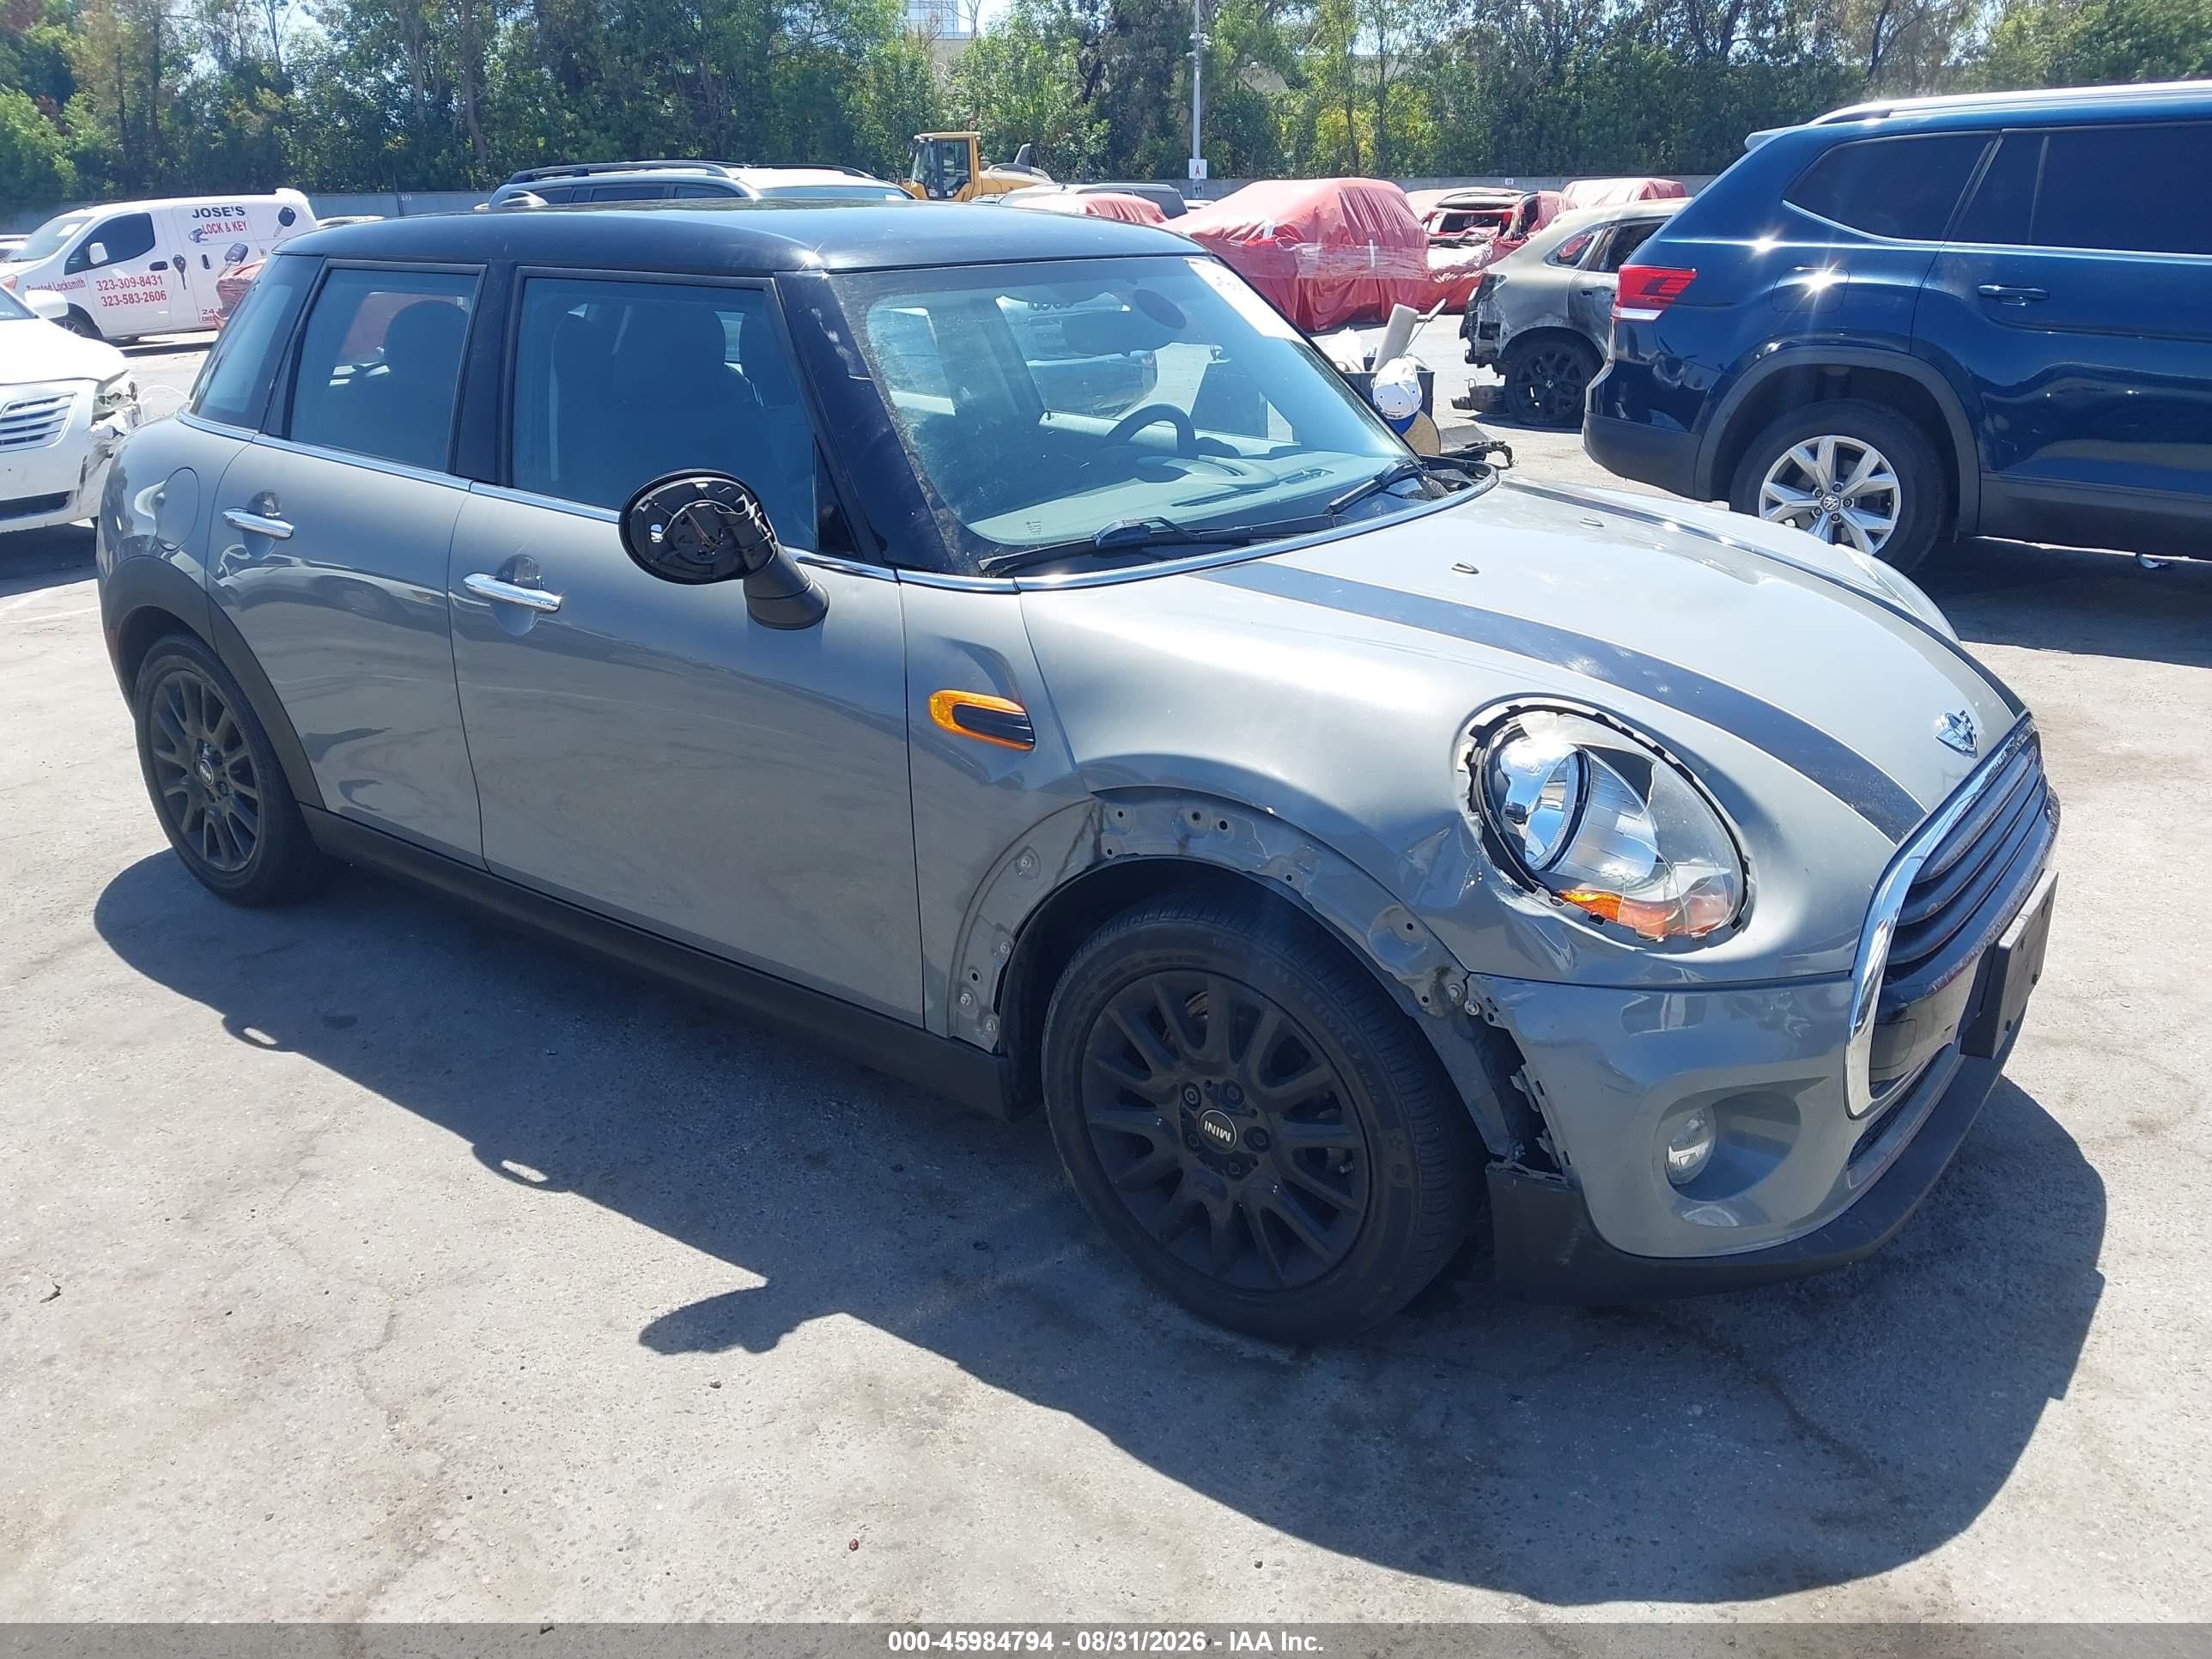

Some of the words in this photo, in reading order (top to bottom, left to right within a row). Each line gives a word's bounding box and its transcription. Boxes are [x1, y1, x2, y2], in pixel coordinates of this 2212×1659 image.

[1194, 164, 1200, 176] A
[191, 205, 246, 218] JOSE'S
[201, 222, 224, 234] LOCK
[224, 222, 231, 233] &
[231, 220, 247, 232] KEY
[52, 276, 86, 292] Locksmith
[95, 274, 163, 291] 323-309-8431
[100, 289, 167, 307] 323-583-2606
[1204, 1120, 1231, 1142] MINI
